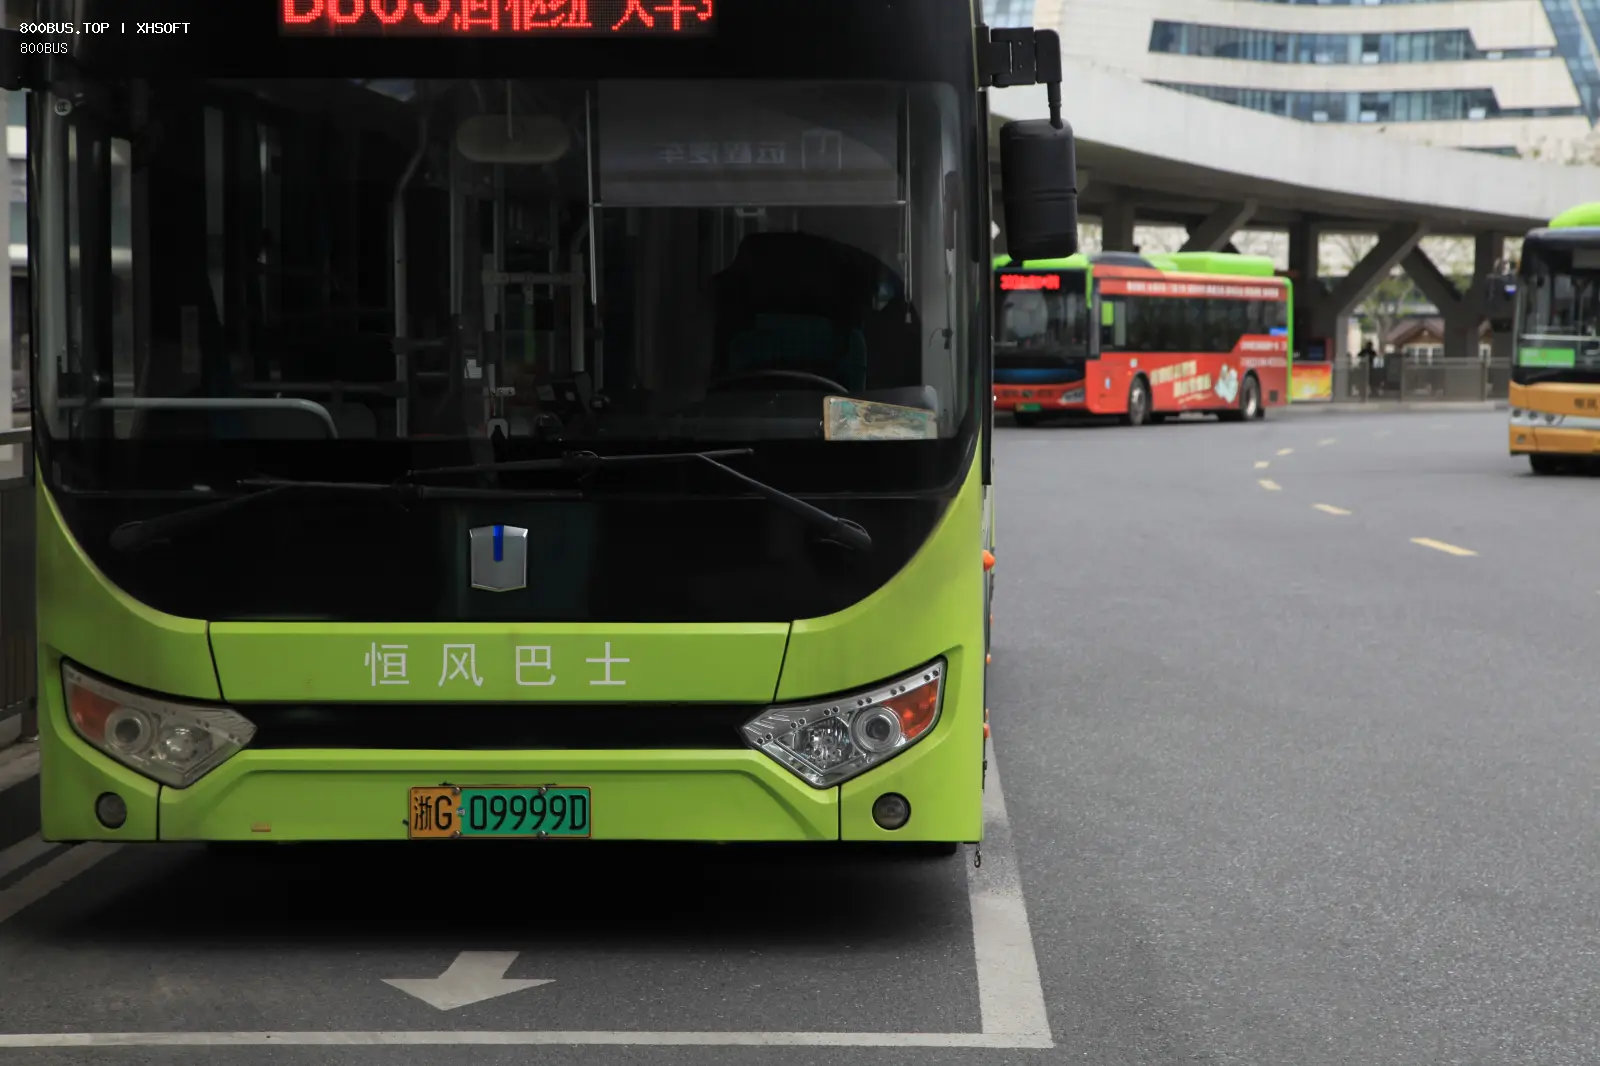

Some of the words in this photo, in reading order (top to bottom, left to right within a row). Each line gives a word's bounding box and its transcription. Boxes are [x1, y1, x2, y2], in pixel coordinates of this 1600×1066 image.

[364, 641, 631, 687] 恒风巴士
[413, 795, 453, 831] 浙G
[469, 794, 588, 831] 09999D
